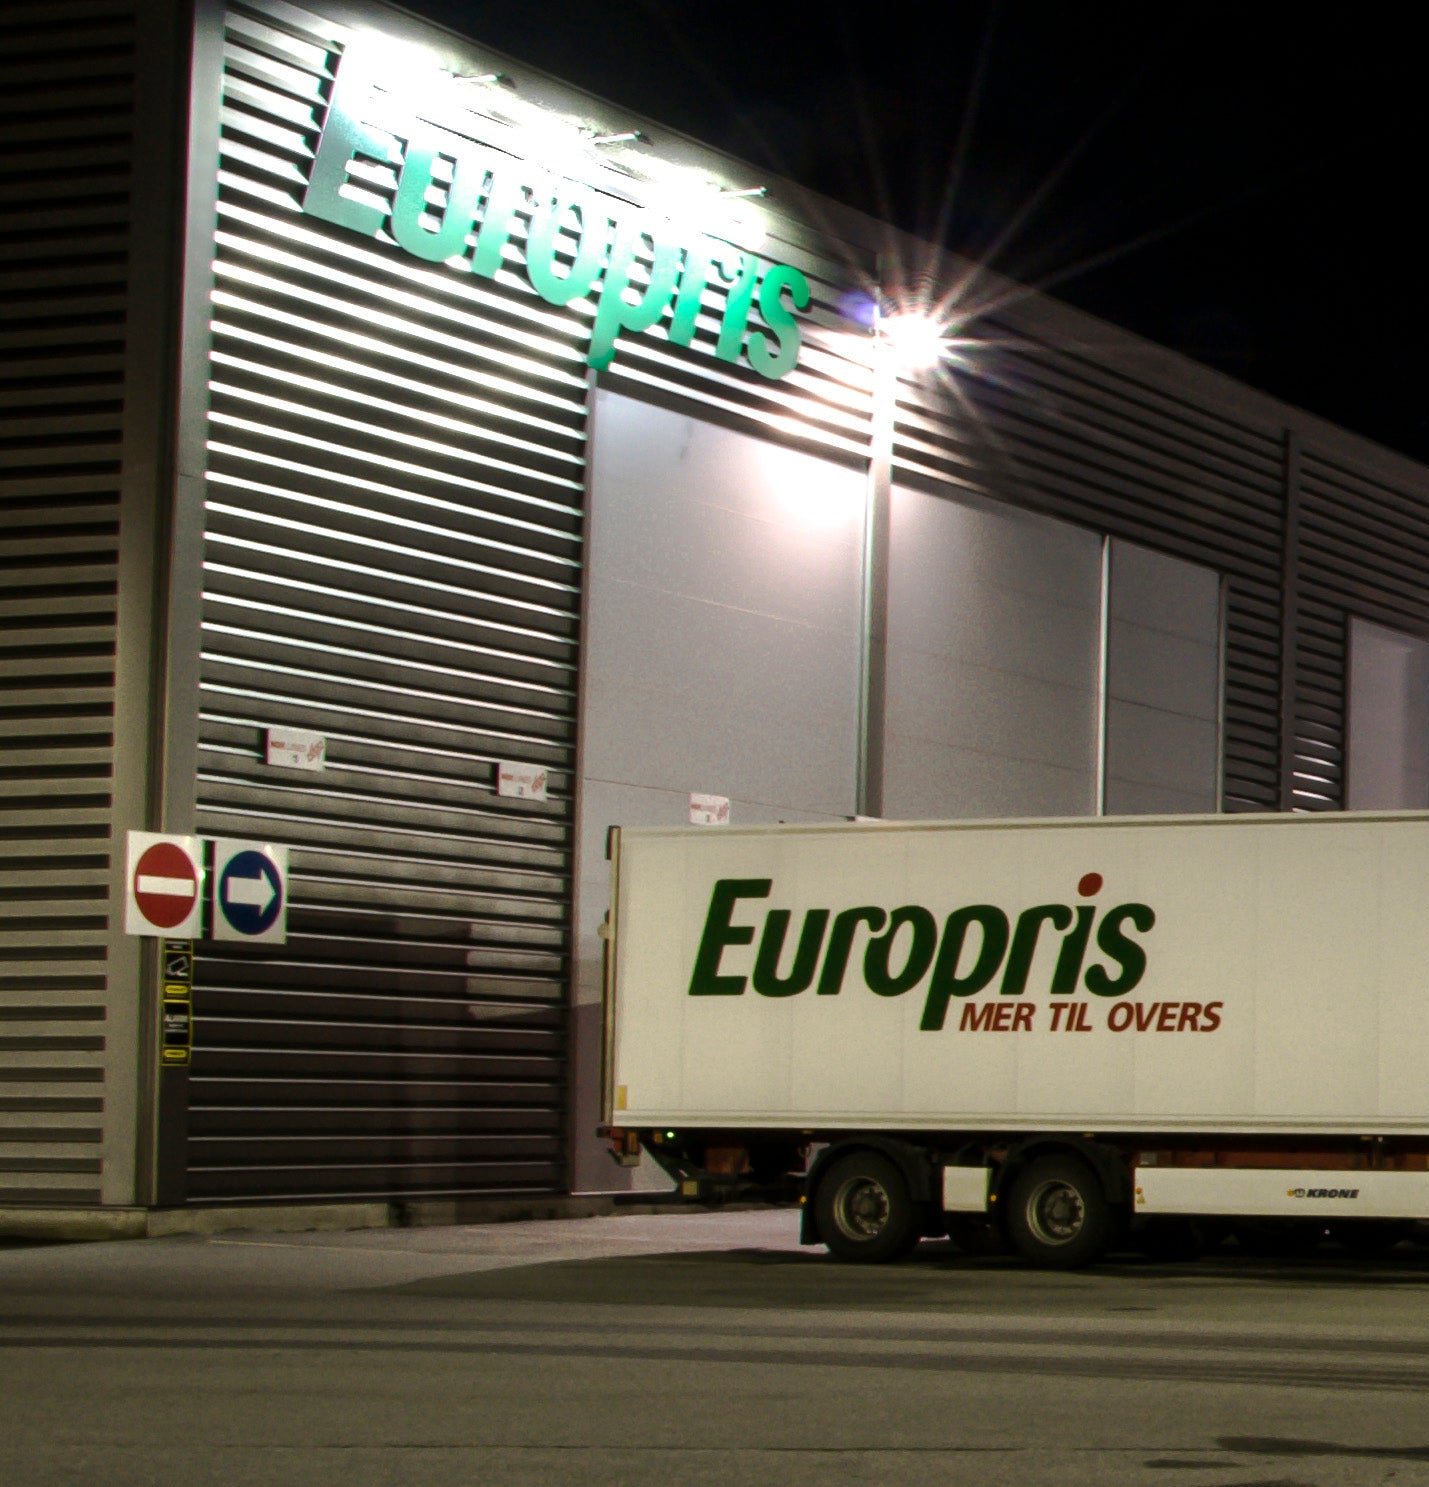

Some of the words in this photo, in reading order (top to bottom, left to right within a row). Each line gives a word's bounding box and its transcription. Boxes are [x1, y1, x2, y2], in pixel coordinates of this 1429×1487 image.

[303, 32, 811, 379] Europris
[688, 872, 1156, 1031] Europris
[959, 1001, 1036, 1032] MER
[1049, 1001, 1093, 1032] TIL
[1107, 1001, 1224, 1032] OVERS
[1306, 1188, 1360, 1199] KRONE
